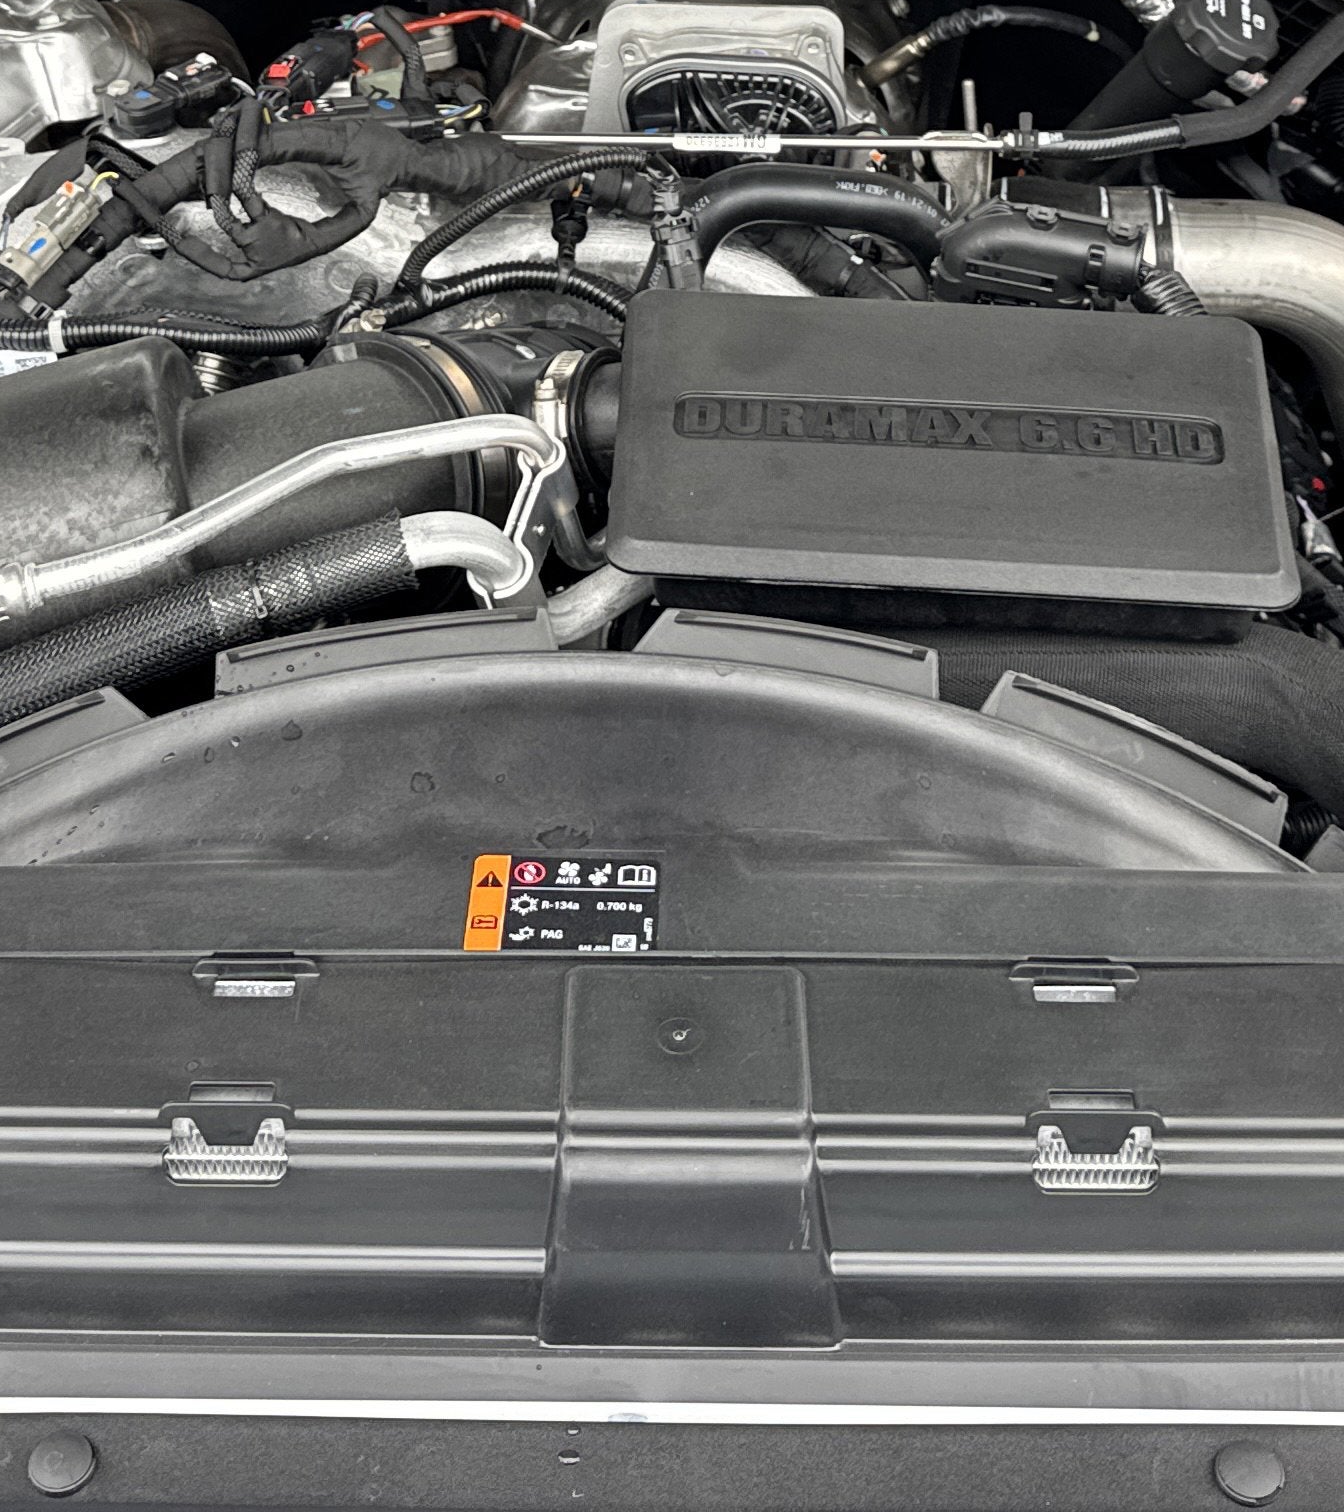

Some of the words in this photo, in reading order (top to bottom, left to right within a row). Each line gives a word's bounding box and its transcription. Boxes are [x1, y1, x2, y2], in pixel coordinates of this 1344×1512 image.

[683, 399, 993, 448] DURAMAX
[1019, 412, 1118, 453] 6.6
[1132, 419, 1217, 460] HD
[555, 876, 581, 885] AUTO
[541, 900, 580, 910] R-134a
[596, 901, 627, 911] 0.700
[628, 901, 643, 913] kg
[540, 929, 564, 940] PAG
